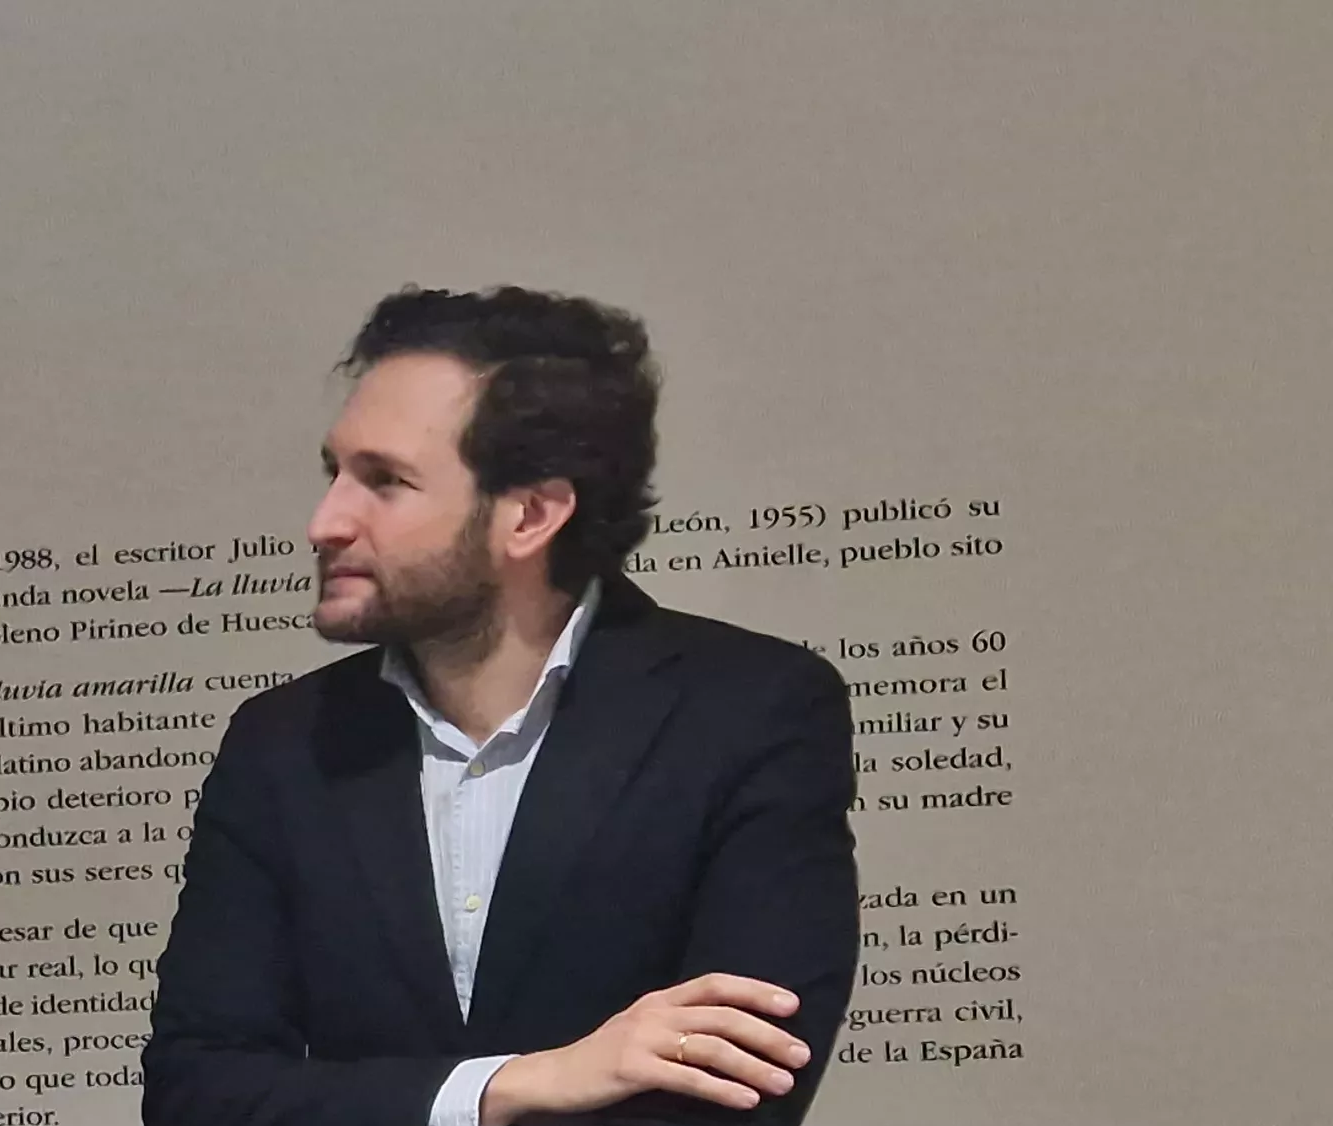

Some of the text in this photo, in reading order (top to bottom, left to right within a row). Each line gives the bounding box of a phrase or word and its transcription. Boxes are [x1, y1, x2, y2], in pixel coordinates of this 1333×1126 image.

[76, 544, 98, 565] el
[115, 542, 215, 564] escritor
[228, 535, 294, 563] Julio
[654, 512, 729, 533] León,
[751, 505, 825, 529] 1955)
[844, 498, 951, 530] publicó
[969, 501, 999, 516] su
[63, 580, 149, 604] novela
[232, 573, 311, 595] lluvia
[669, 556, 701, 570] en
[713, 544, 829, 569] Ainielle,
[841, 537, 940, 568] pueblo
[952, 535, 1002, 556] sito
[71, 619, 167, 640] Pirineo
[178, 613, 209, 634] de
[73, 672, 193, 697] amarilla
[840, 638, 879, 659] los
[893, 636, 959, 656] años
[972, 630, 1005, 653] 60
[84, 712, 215, 734] habitante
[982, 669, 1006, 691] el
[80, 747, 217, 772] abandono
[952, 717, 966, 737] y
[978, 714, 1008, 729] su
[48, 786, 171, 809] deterioro
[854, 751, 879, 775] la
[892, 746, 1011, 772] soledad,
[118, 829, 131, 843] a
[144, 822, 165, 842] la
[879, 795, 908, 810] su
[922, 785, 1012, 809] madre
[32, 869, 74, 884] sus
[85, 865, 152, 881] seres
[64, 918, 96, 939] de
[109, 923, 157, 943] que
[932, 891, 966, 906] en
[981, 889, 1016, 904] un
[28, 956, 83, 979] real,
[94, 954, 118, 975] lo
[900, 925, 922, 946] la
[935, 921, 1018, 951] pérdi-
[862, 965, 901, 986] los
[913, 961, 1020, 984] núcleos
[848, 1006, 943, 1032] guerra
[955, 999, 1022, 1023] civil,
[26, 1074, 74, 1094] que
[839, 1042, 872, 1063] de
[885, 1041, 908, 1062] la
[921, 1039, 1023, 1066] España
